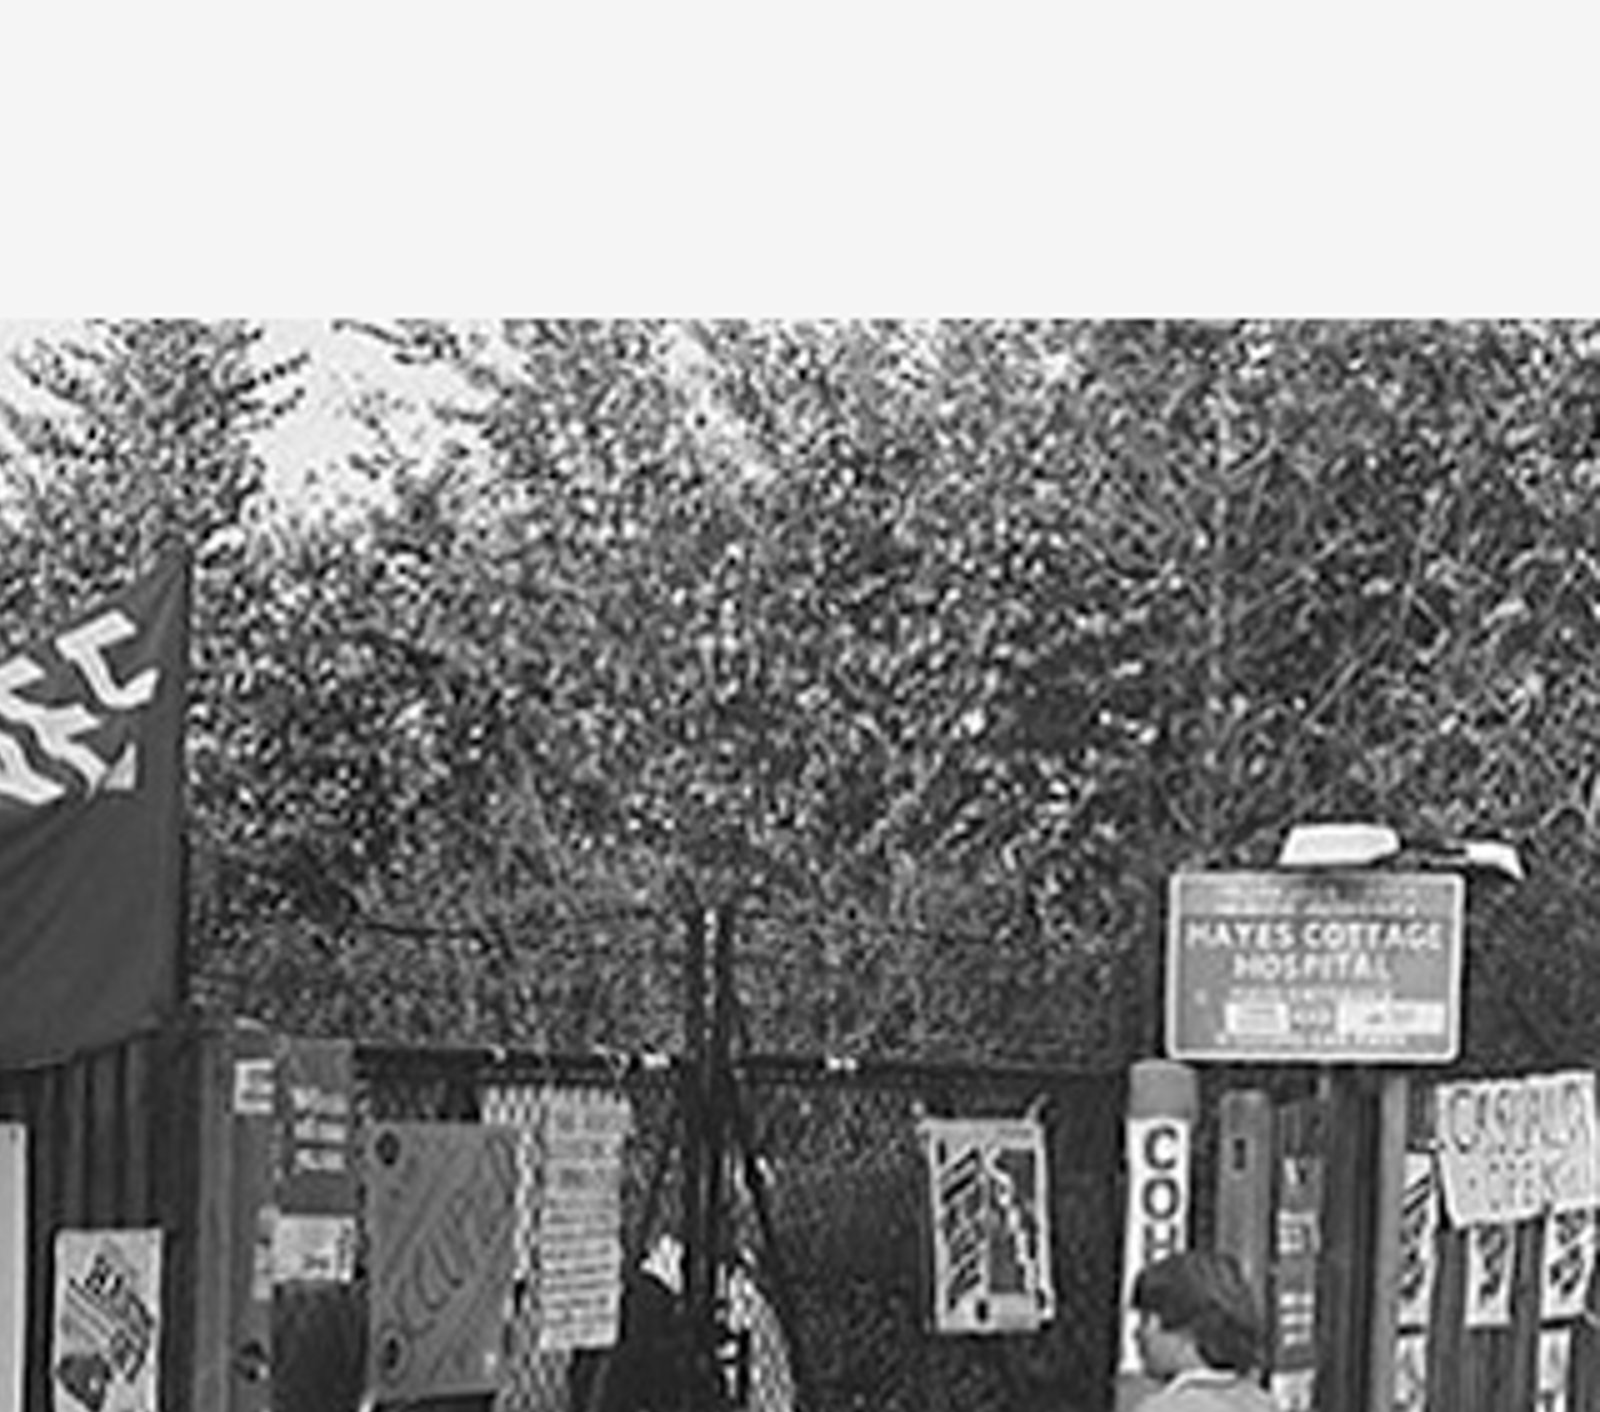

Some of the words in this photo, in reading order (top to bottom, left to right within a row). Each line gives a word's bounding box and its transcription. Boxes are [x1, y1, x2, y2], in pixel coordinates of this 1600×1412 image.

[1185, 921, 1295, 950] HAYES
[1302, 921, 1443, 950] COTTAGE
[1232, 952, 1391, 981] HOSPITAL
